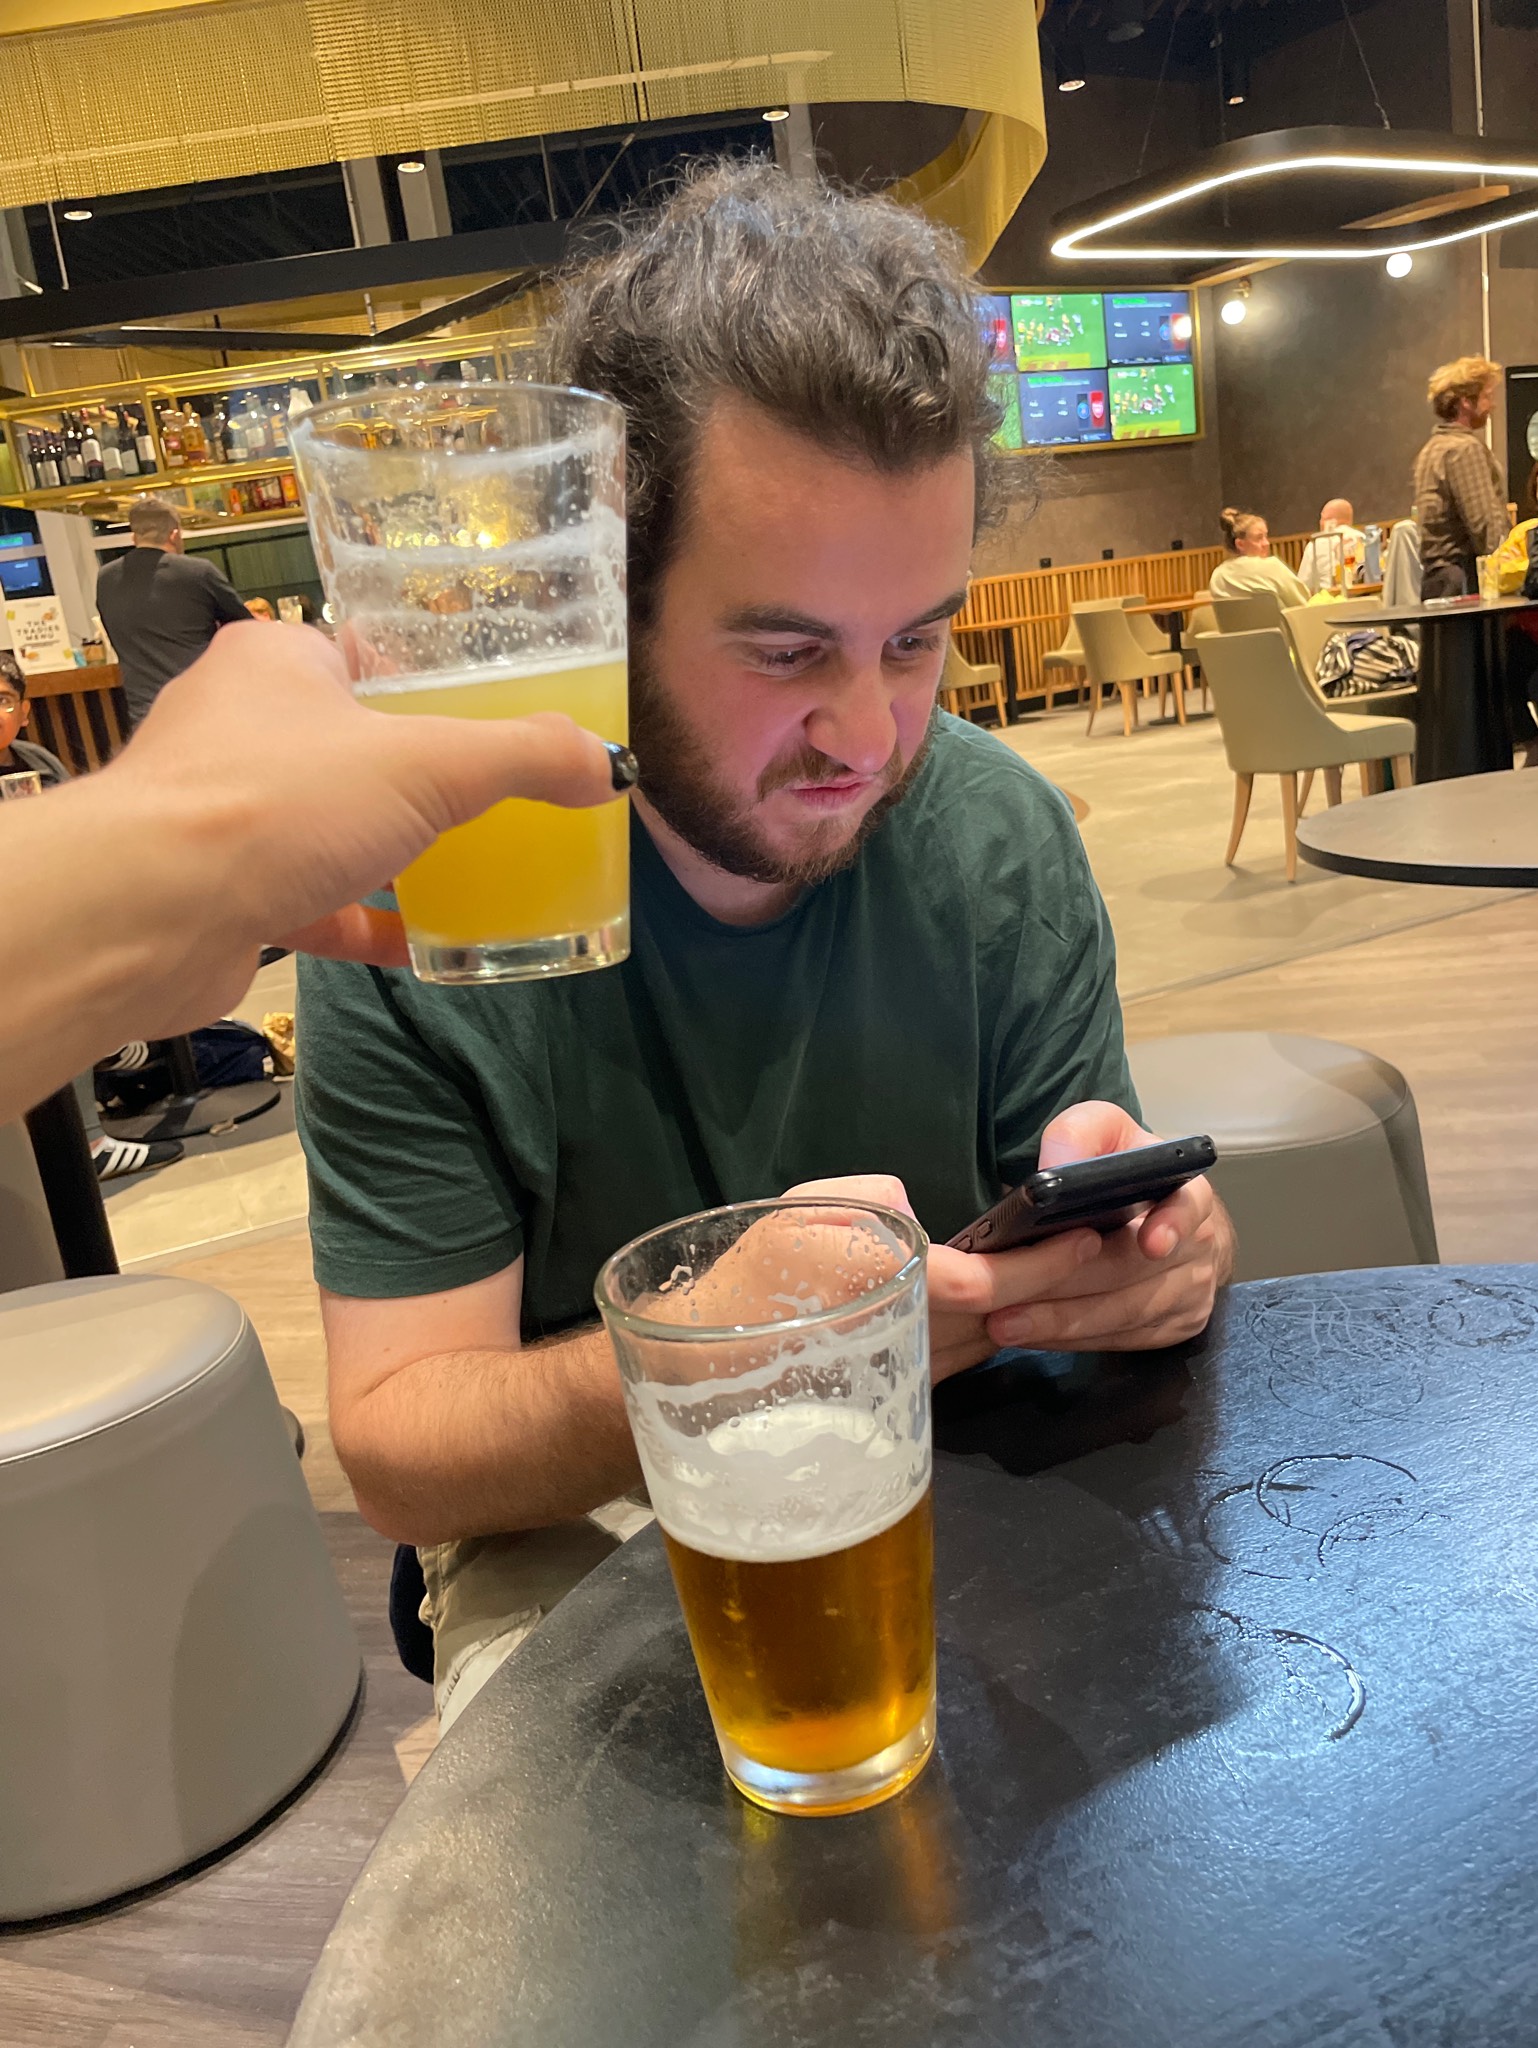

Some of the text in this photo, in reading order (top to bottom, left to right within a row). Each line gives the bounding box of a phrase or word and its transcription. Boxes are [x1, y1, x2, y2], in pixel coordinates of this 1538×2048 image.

[27, 620, 46, 628] THE
[16, 624, 60, 636] TRADIES
[26, 633, 54, 641] MENU
